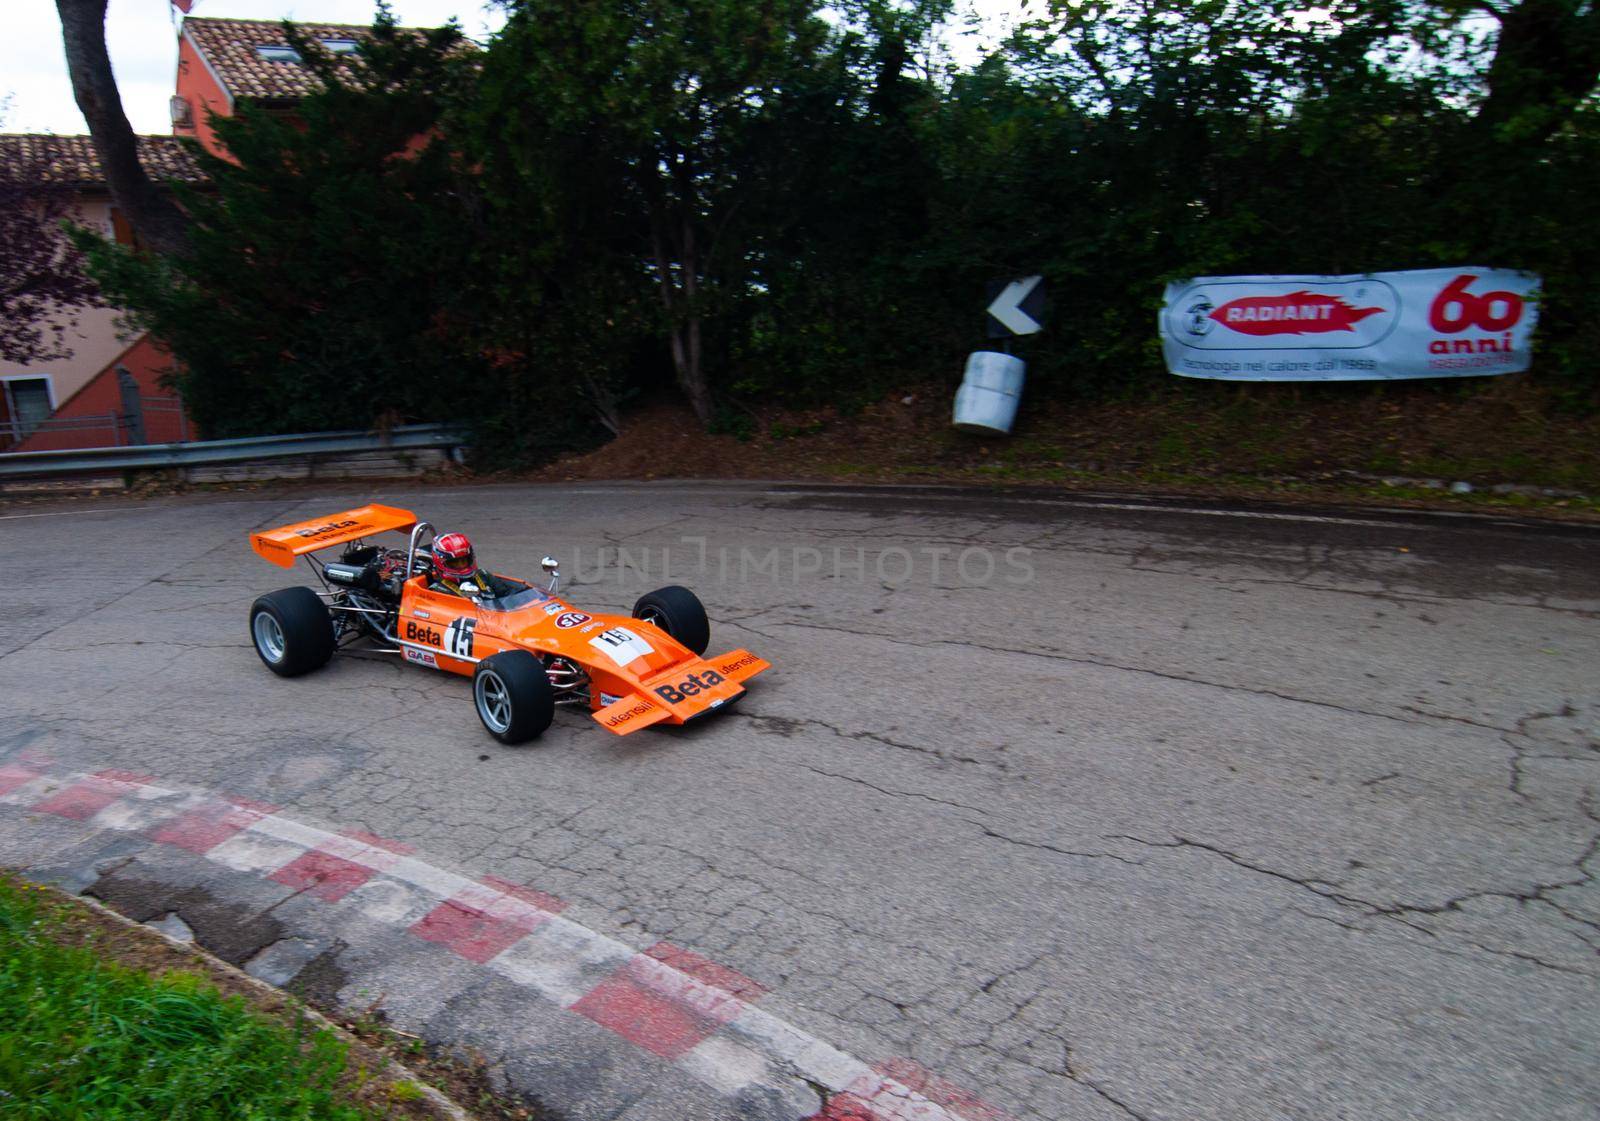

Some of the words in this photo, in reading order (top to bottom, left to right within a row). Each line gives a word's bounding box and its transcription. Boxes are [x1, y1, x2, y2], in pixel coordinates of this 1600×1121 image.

[1226, 304, 1334, 323] RADIANT
[1427, 274, 1525, 334] 60
[1428, 332, 1514, 355] anni
[296, 521, 359, 538] Beta
[560, 612, 585, 627] STP
[406, 621, 441, 647] Beta
[452, 616, 477, 657] 15
[598, 629, 633, 648] 15
[407, 649, 435, 664] GABI
[654, 669, 727, 705] Beta
[718, 652, 760, 676] utensili
[606, 699, 655, 727] utensili
